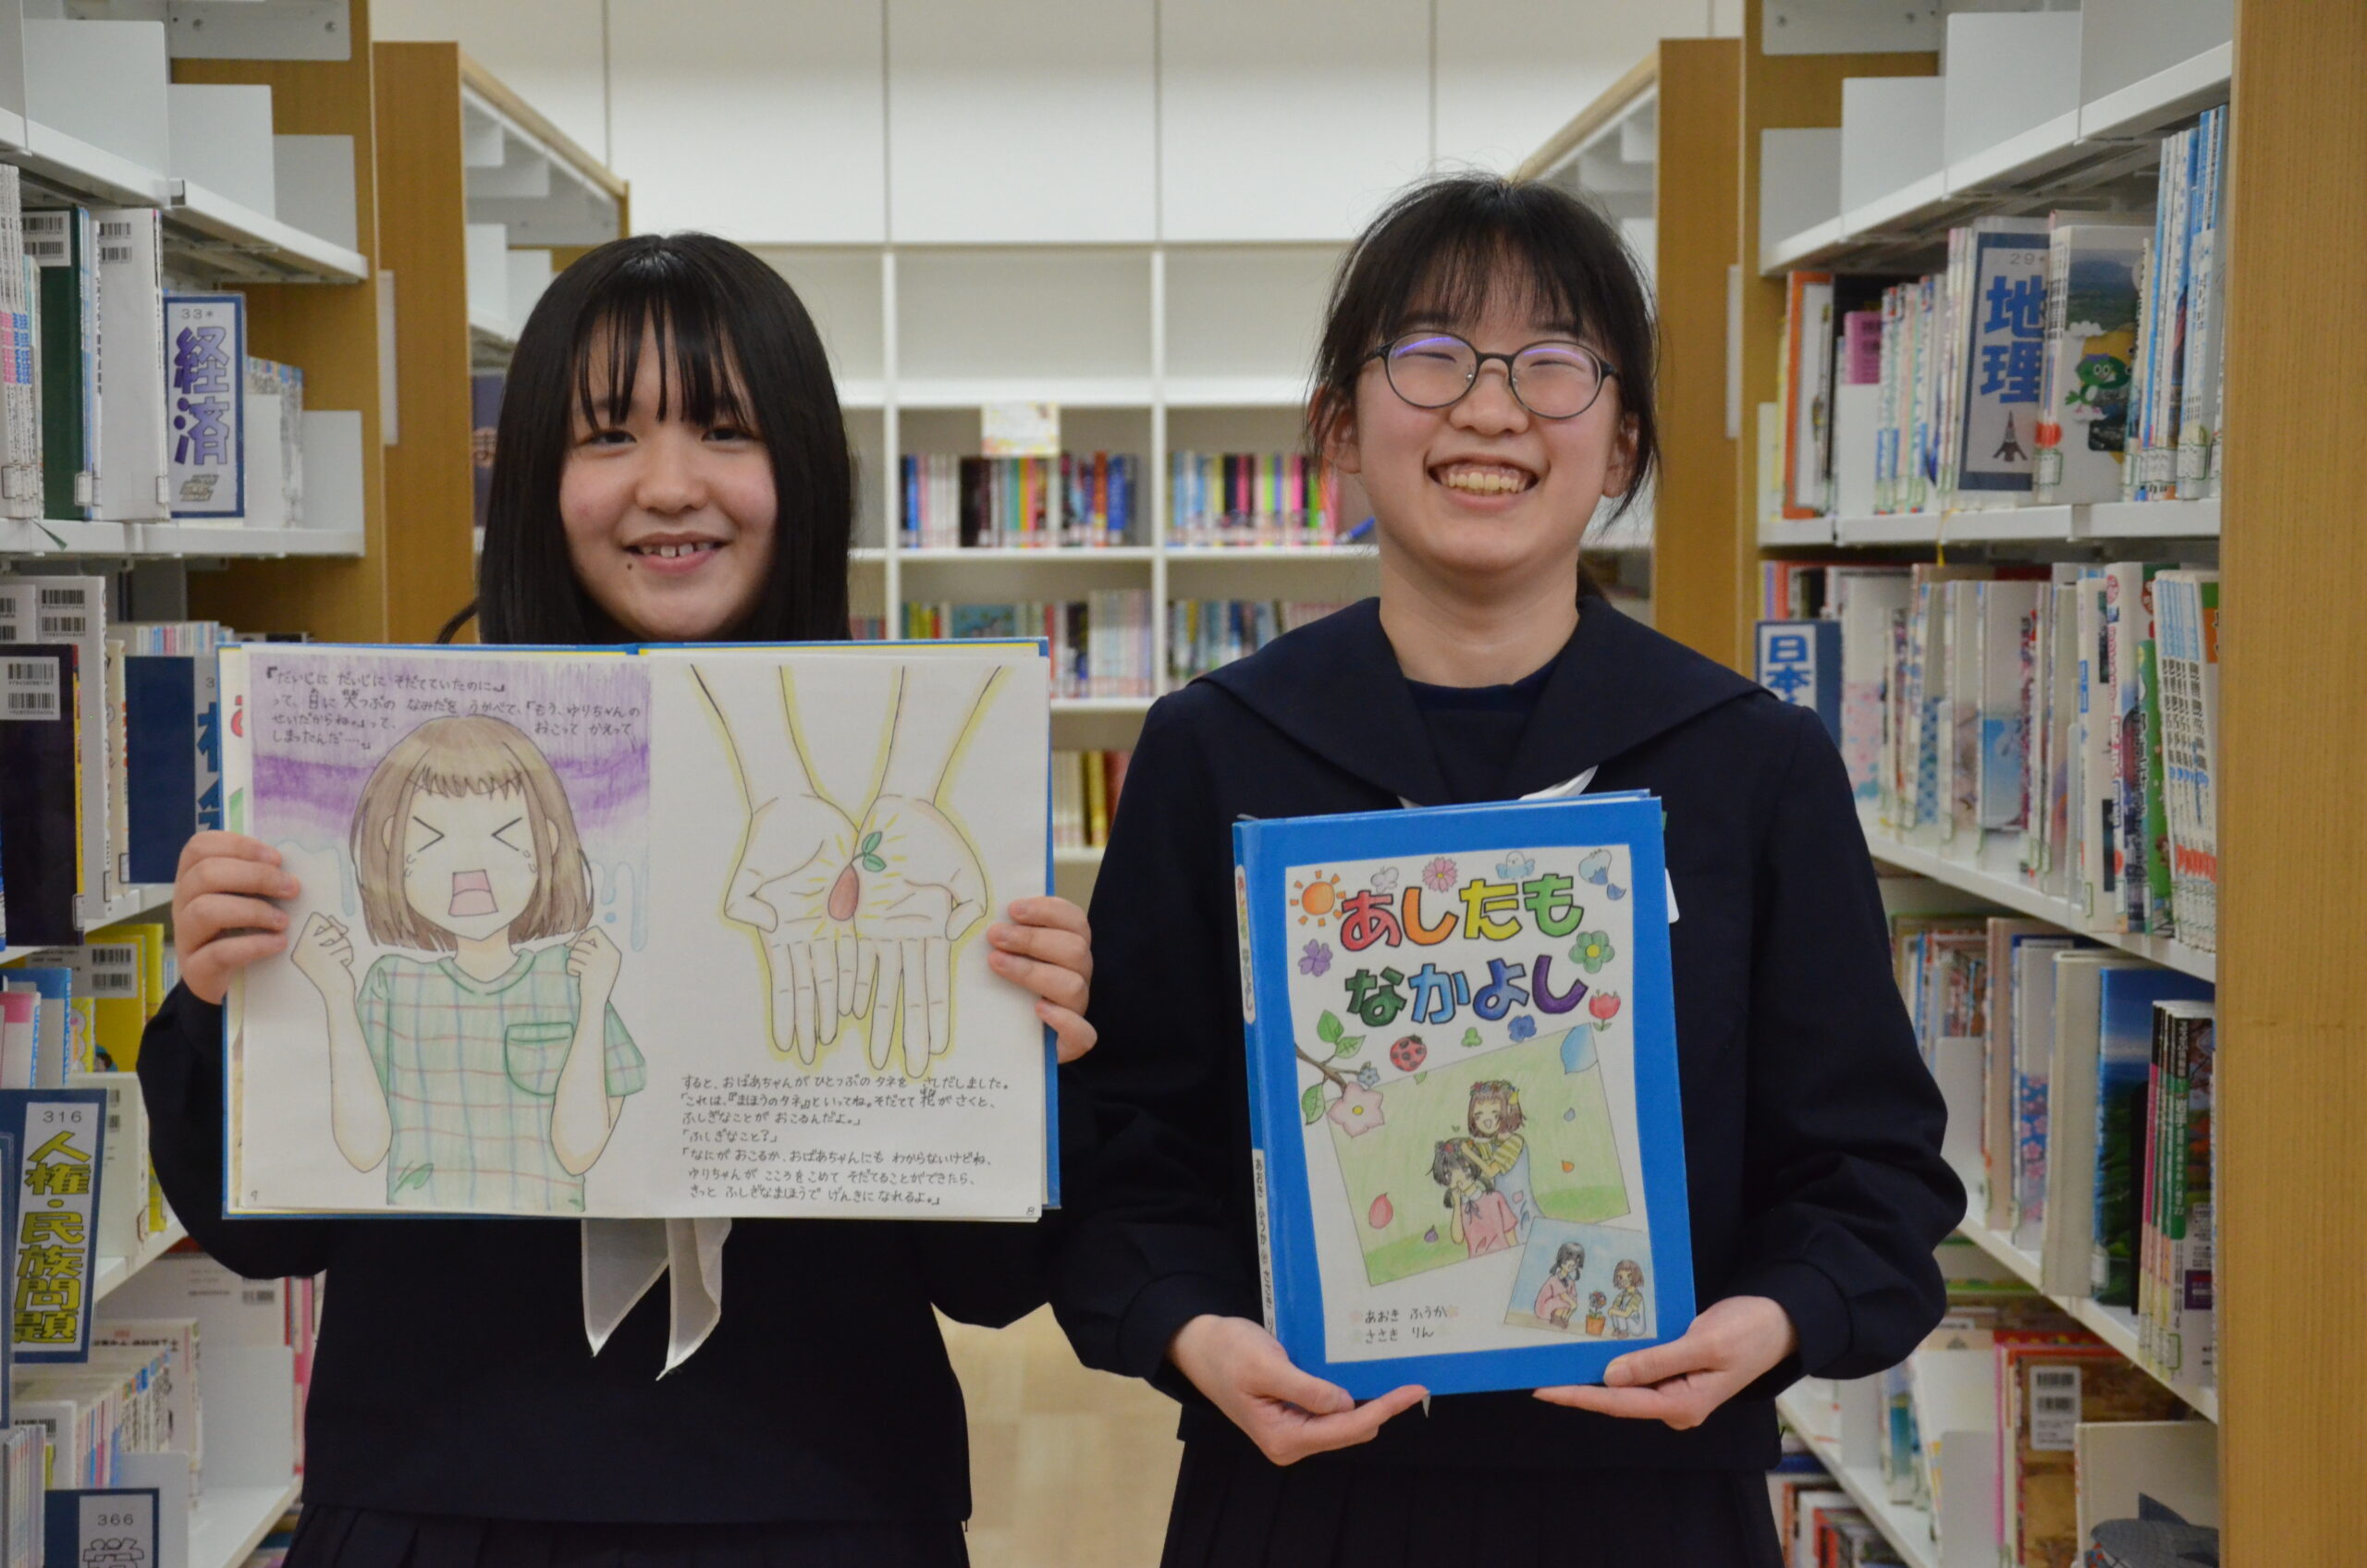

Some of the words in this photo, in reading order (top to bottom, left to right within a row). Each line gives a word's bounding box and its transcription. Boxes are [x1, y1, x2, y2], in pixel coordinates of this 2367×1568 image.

[1981, 275, 2048, 404] 地理
[174, 326, 230, 465] 経済
[1767, 634, 1811, 704] 日本
[1340, 874, 1585, 952] あしたも
[1344, 954, 1589, 1027] なかよし
[43, 1110, 82, 1123] 316
[14, 1131, 92, 1343] 人権・民族問題
[1365, 1308, 1399, 1324] あおき
[1410, 1305, 1448, 1320] ふうか
[1366, 1328, 1398, 1344] ささき
[1411, 1326, 1435, 1340] りん
[97, 1513, 134, 1526] 366
